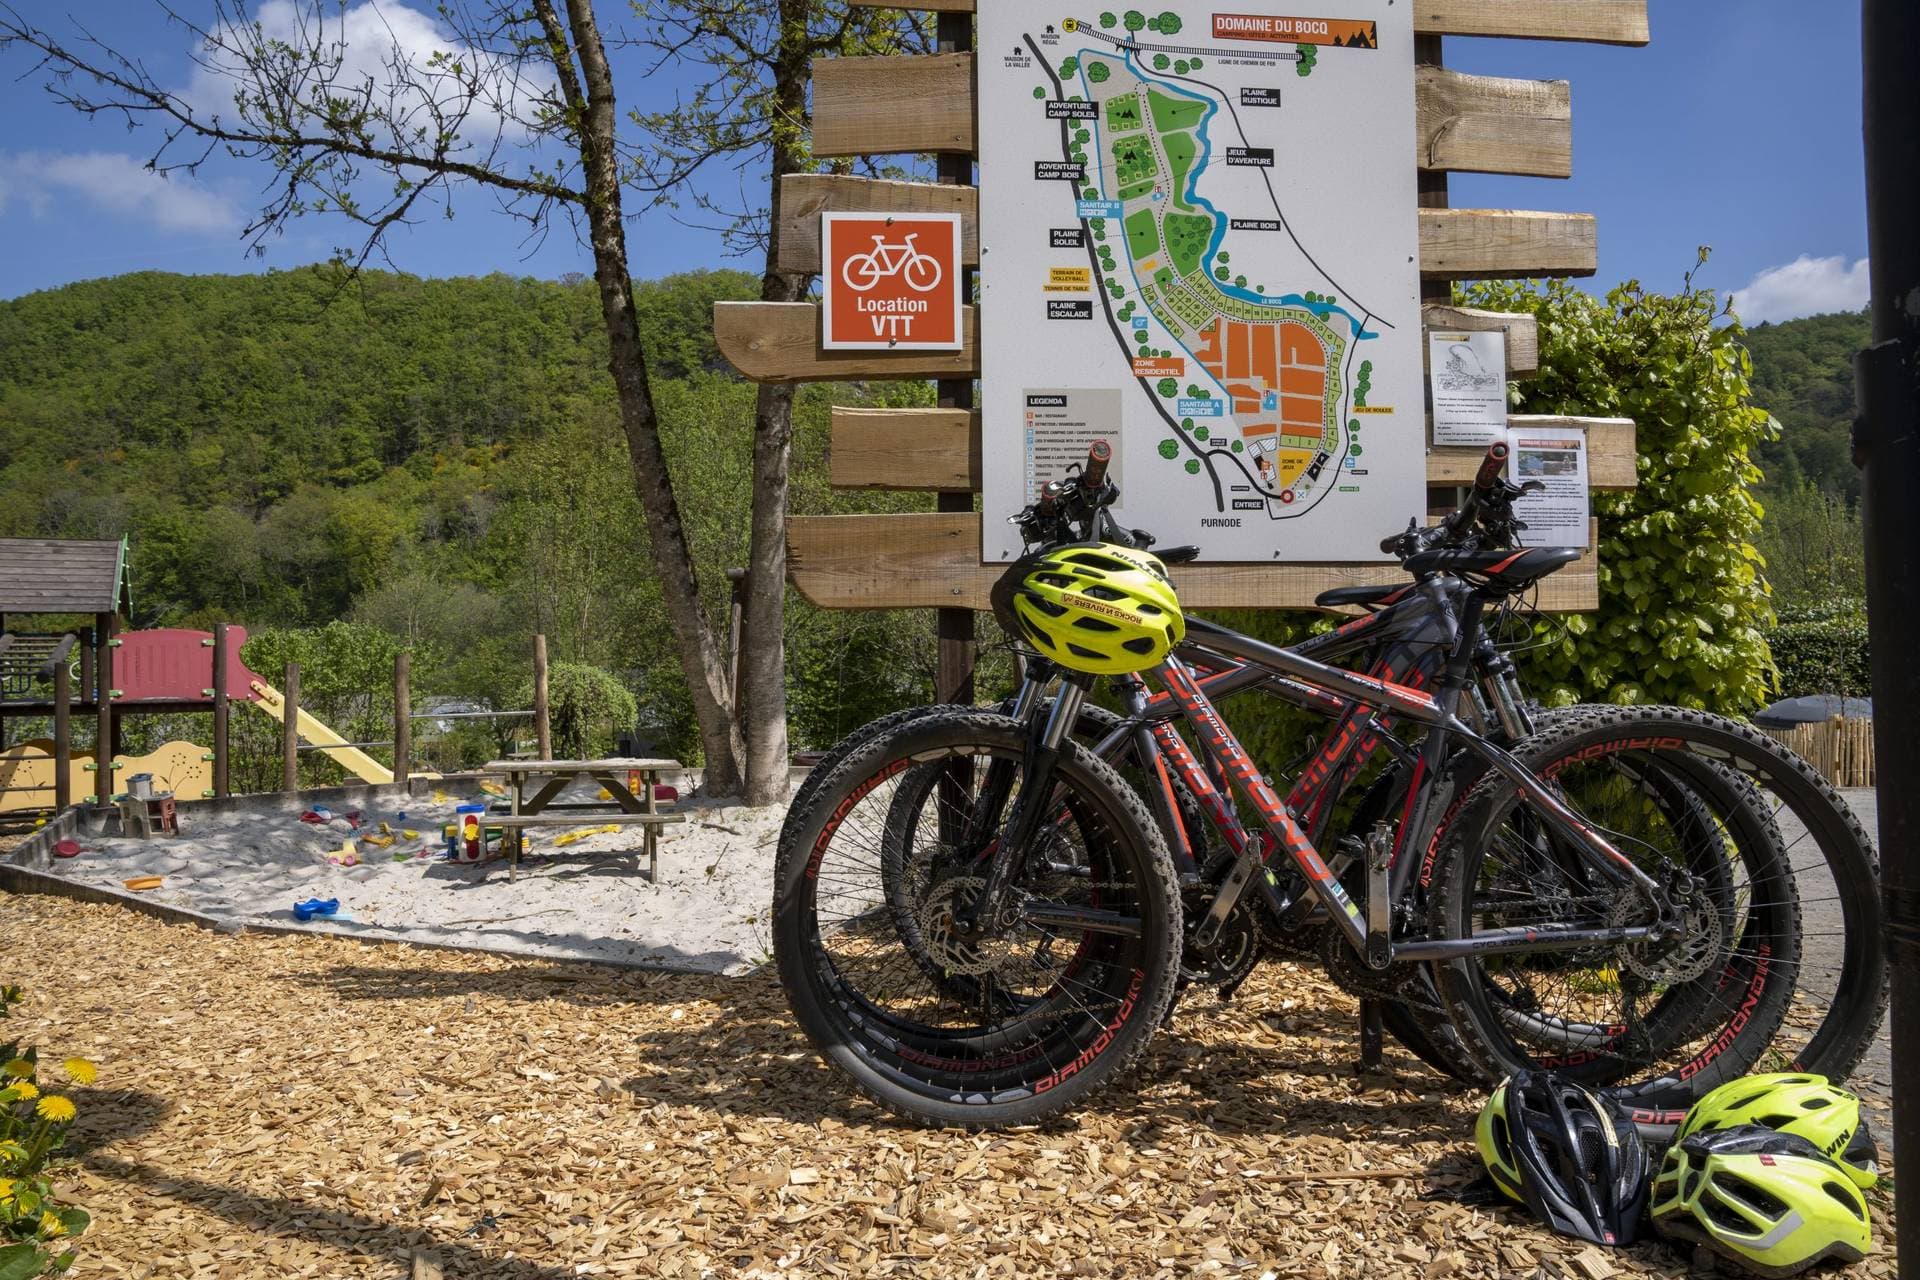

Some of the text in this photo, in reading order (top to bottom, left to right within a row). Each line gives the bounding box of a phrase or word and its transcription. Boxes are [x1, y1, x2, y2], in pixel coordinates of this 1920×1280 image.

[1216, 18, 1328, 35] DOMAINE DU BOCQ
[858, 297, 928, 312] Location
[872, 315, 914, 336] VTT
[1201, 519, 1241, 527] PURNODE
[1074, 600, 1105, 612] RIVERS
[1192, 694, 1242, 760] DIAMOND
[1679, 974, 1765, 1081] DIAMOND
[1035, 998, 1133, 1093] DIAMOND
[1824, 1129, 1850, 1158] WIN
